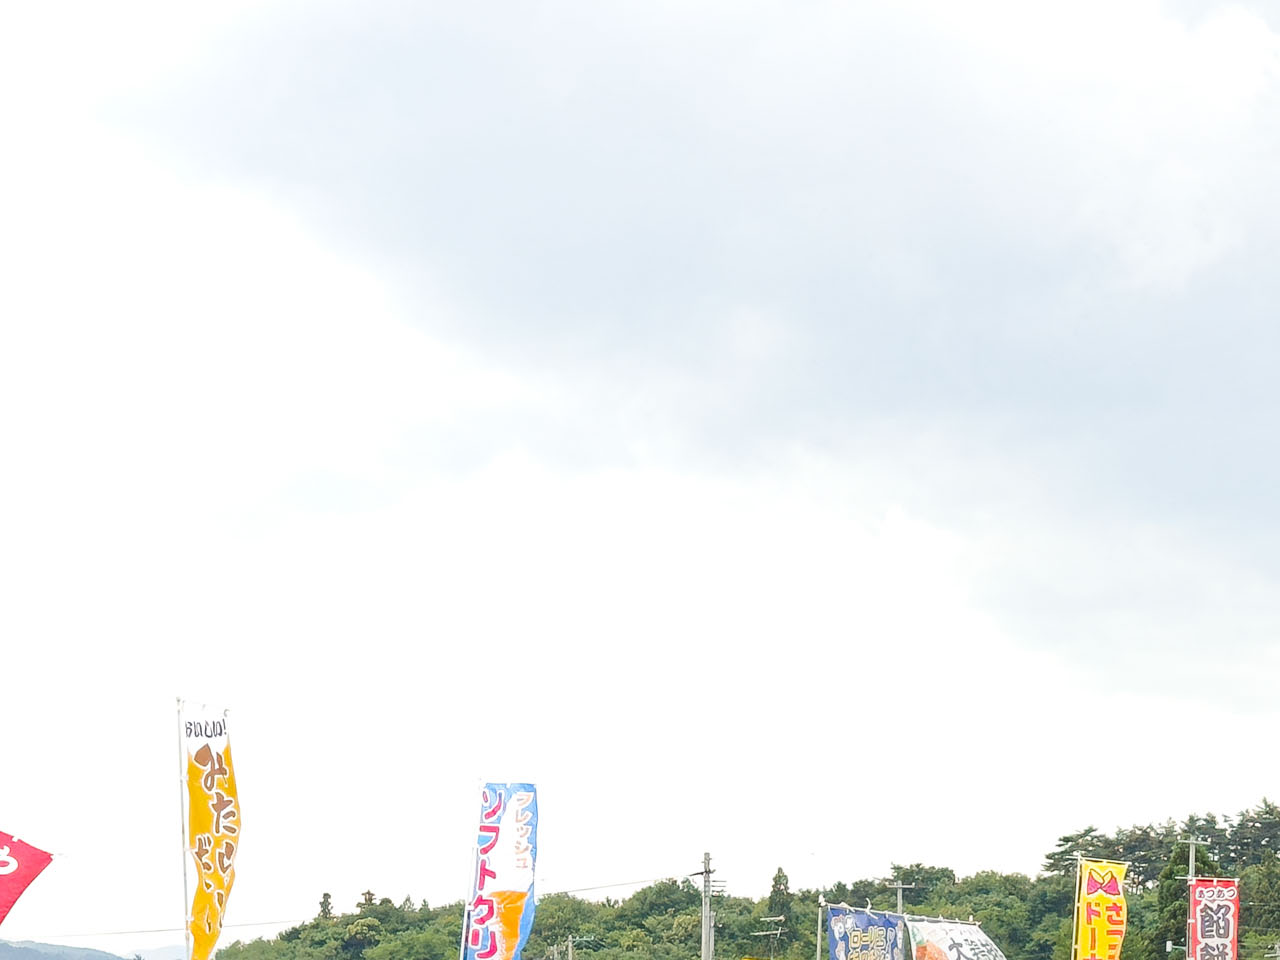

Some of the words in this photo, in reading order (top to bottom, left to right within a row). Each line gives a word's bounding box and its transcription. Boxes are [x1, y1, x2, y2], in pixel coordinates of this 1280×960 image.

[515, 793, 533, 869] フレッシュ
[1197, 887, 1236, 899] あつあつ
